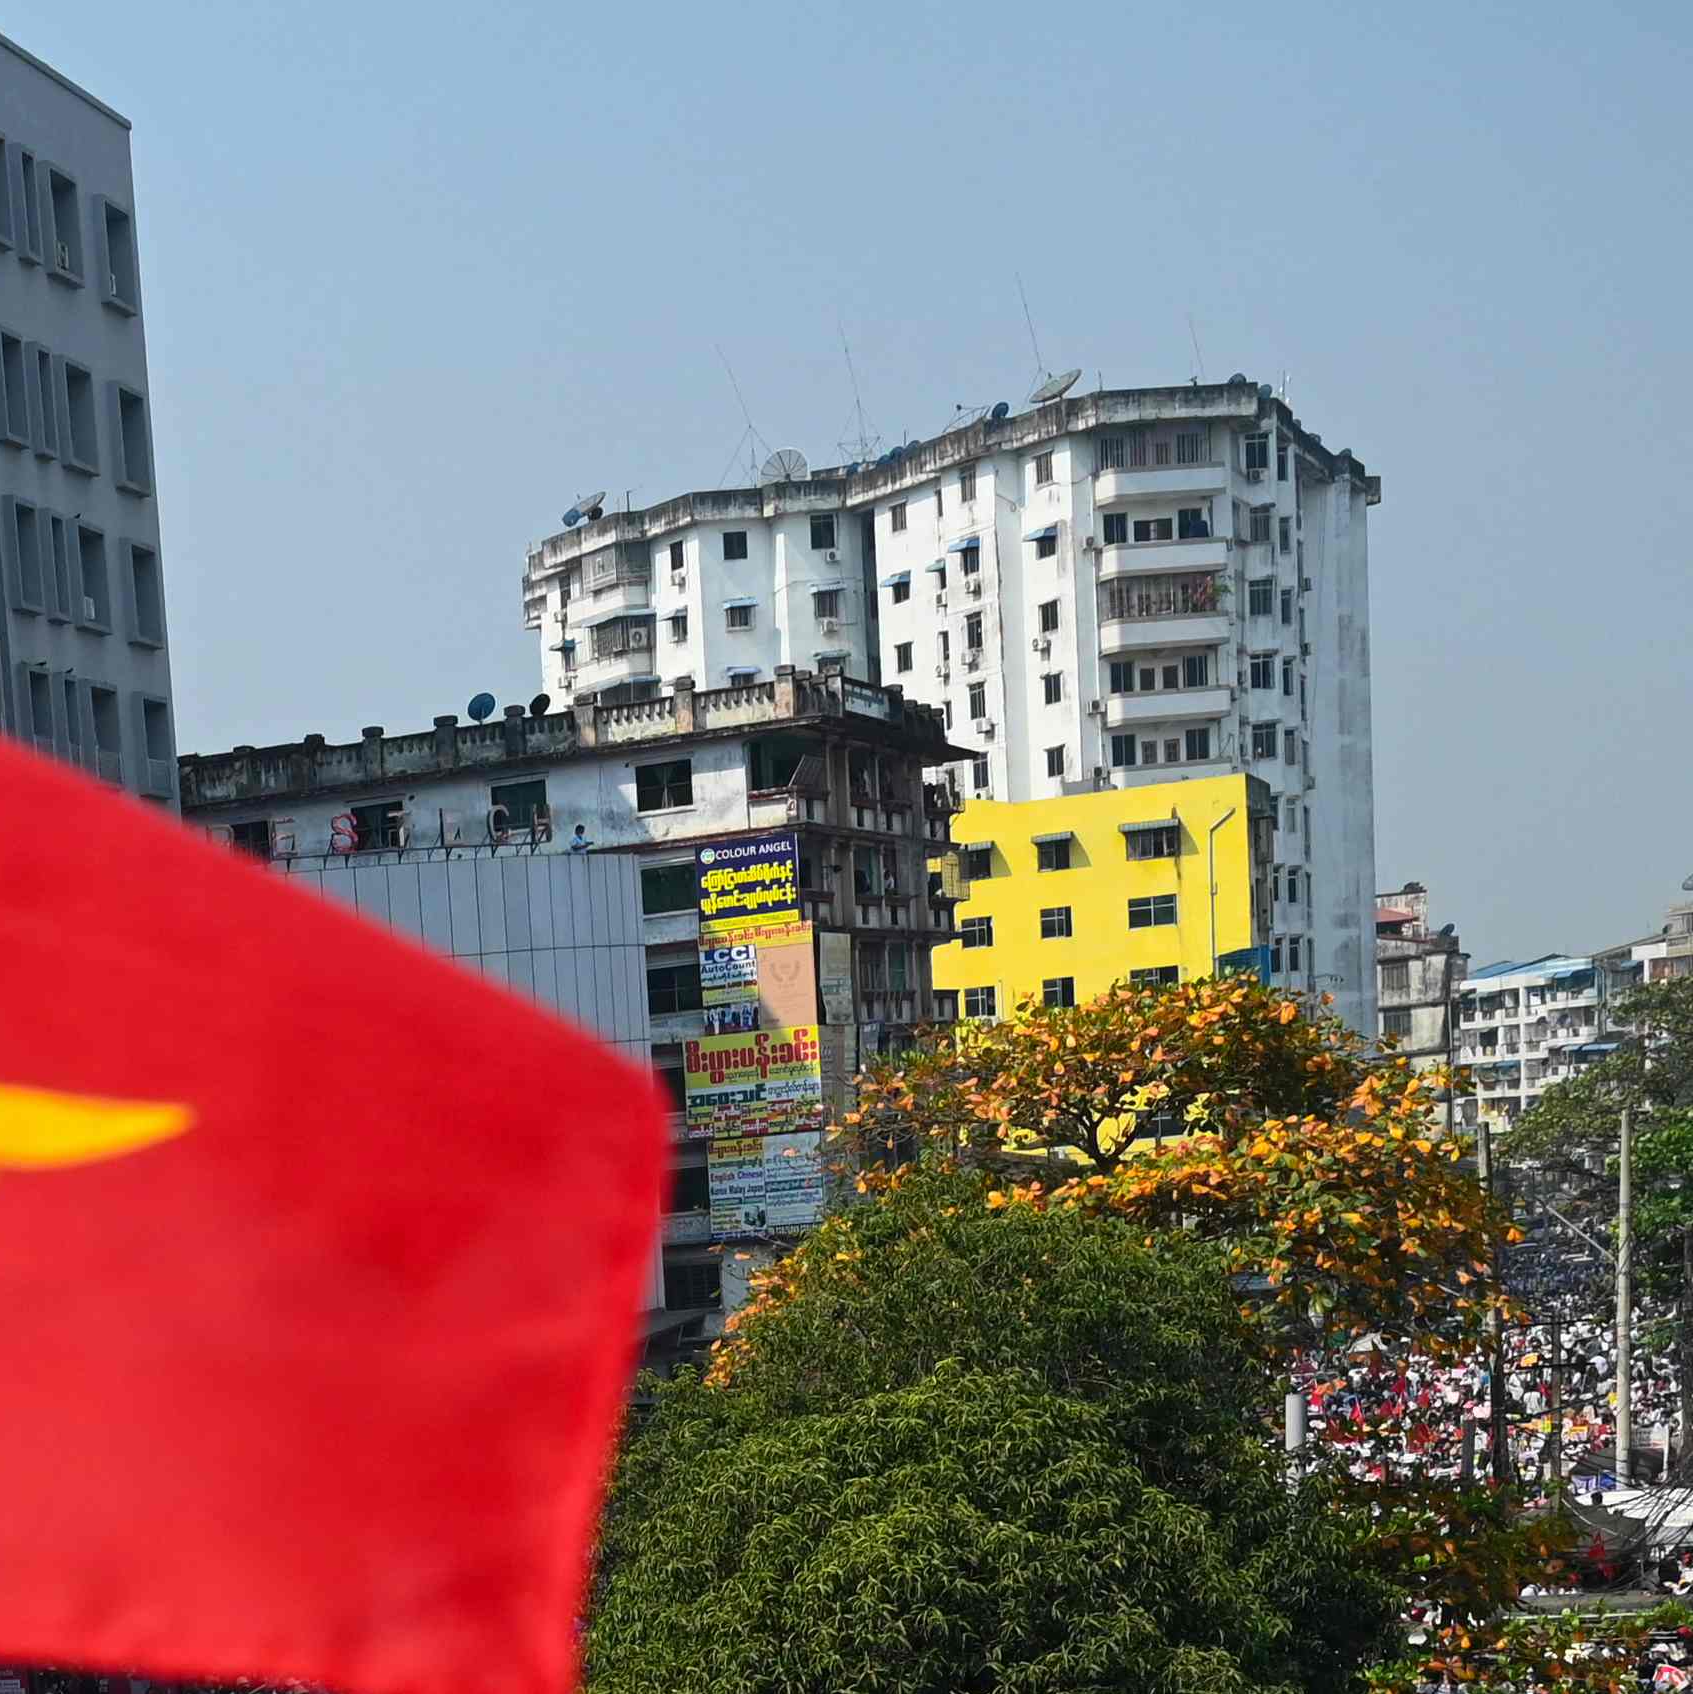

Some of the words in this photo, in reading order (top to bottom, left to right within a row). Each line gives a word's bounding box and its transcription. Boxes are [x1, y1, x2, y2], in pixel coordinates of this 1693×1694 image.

[715, 846, 756, 860] COLOUR
[758, 841, 792, 854] ANGEL
[700, 945, 755, 964] LCCI
